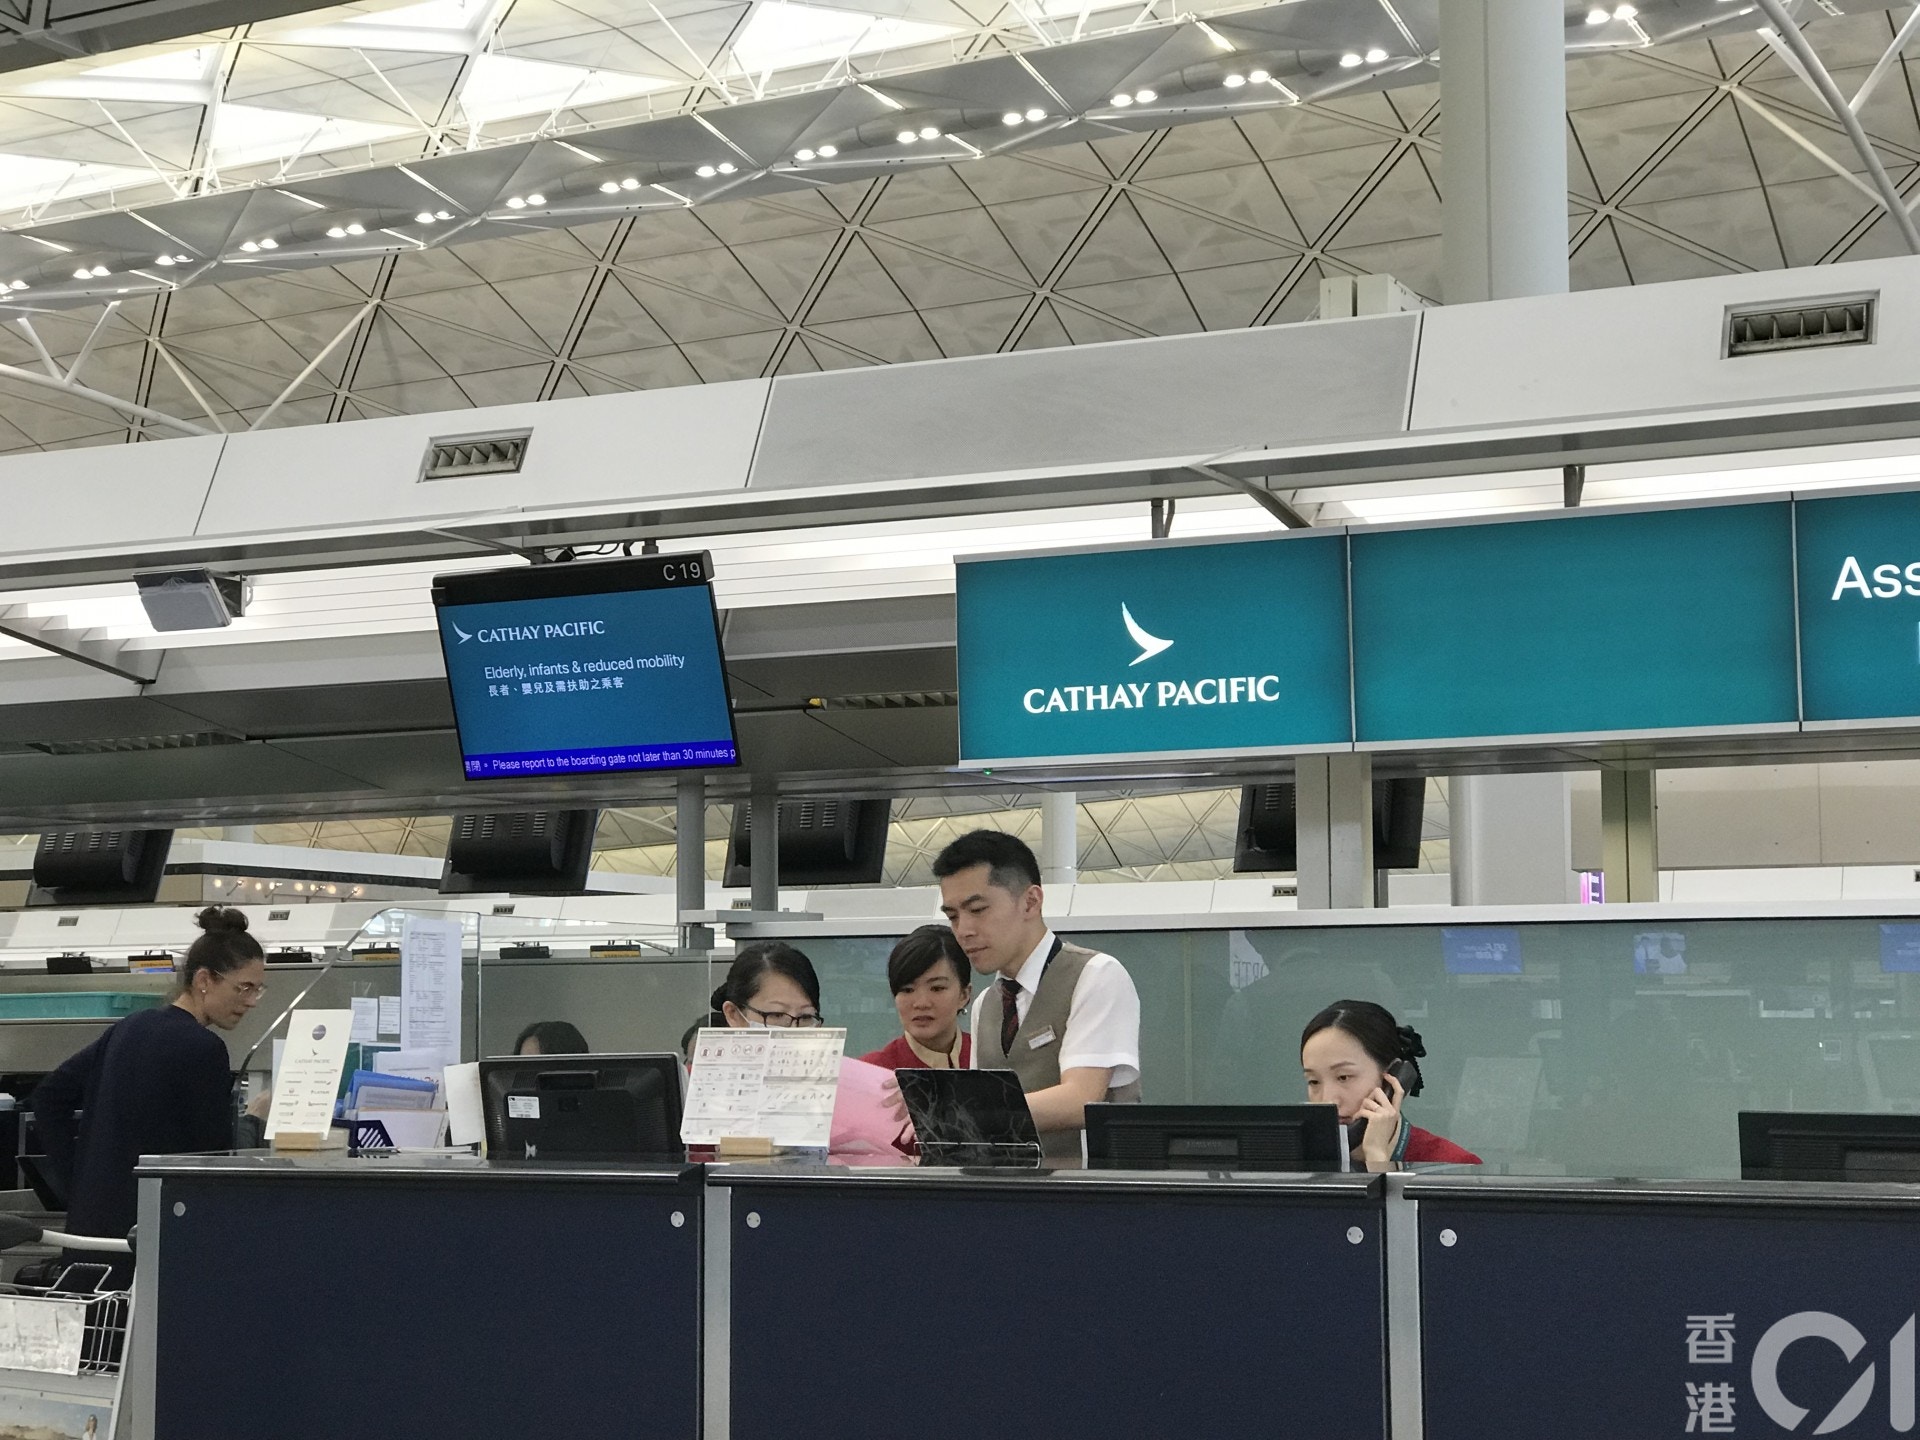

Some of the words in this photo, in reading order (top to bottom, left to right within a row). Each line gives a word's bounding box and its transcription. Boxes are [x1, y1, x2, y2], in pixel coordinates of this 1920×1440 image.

[663, 564, 676, 581] C
[679, 562, 701, 579] 19
[477, 625, 541, 643] CATHAY
[544, 620, 606, 639] PACIFIC
[484, 665, 527, 680] Elderly,
[528, 662, 570, 676] infants
[572, 660, 581, 674] &
[583, 657, 634, 673] reduced
[636, 653, 686, 669] mobility
[1023, 682, 1152, 714] CATHAY
[1157, 675, 1280, 708] PACIFIC
[492, 759, 520, 771] Please
[522, 757, 546, 771] report
[546, 757, 555, 767] to
[556, 756, 569, 766] the
[570, 753, 607, 767] boarding
[608, 753, 626, 767] gate
[628, 752, 641, 763] not
[642, 751, 660, 762] later
[662, 750, 681, 761] than
[683, 748, 694, 760] 30
[695, 748, 728, 760] minutes
